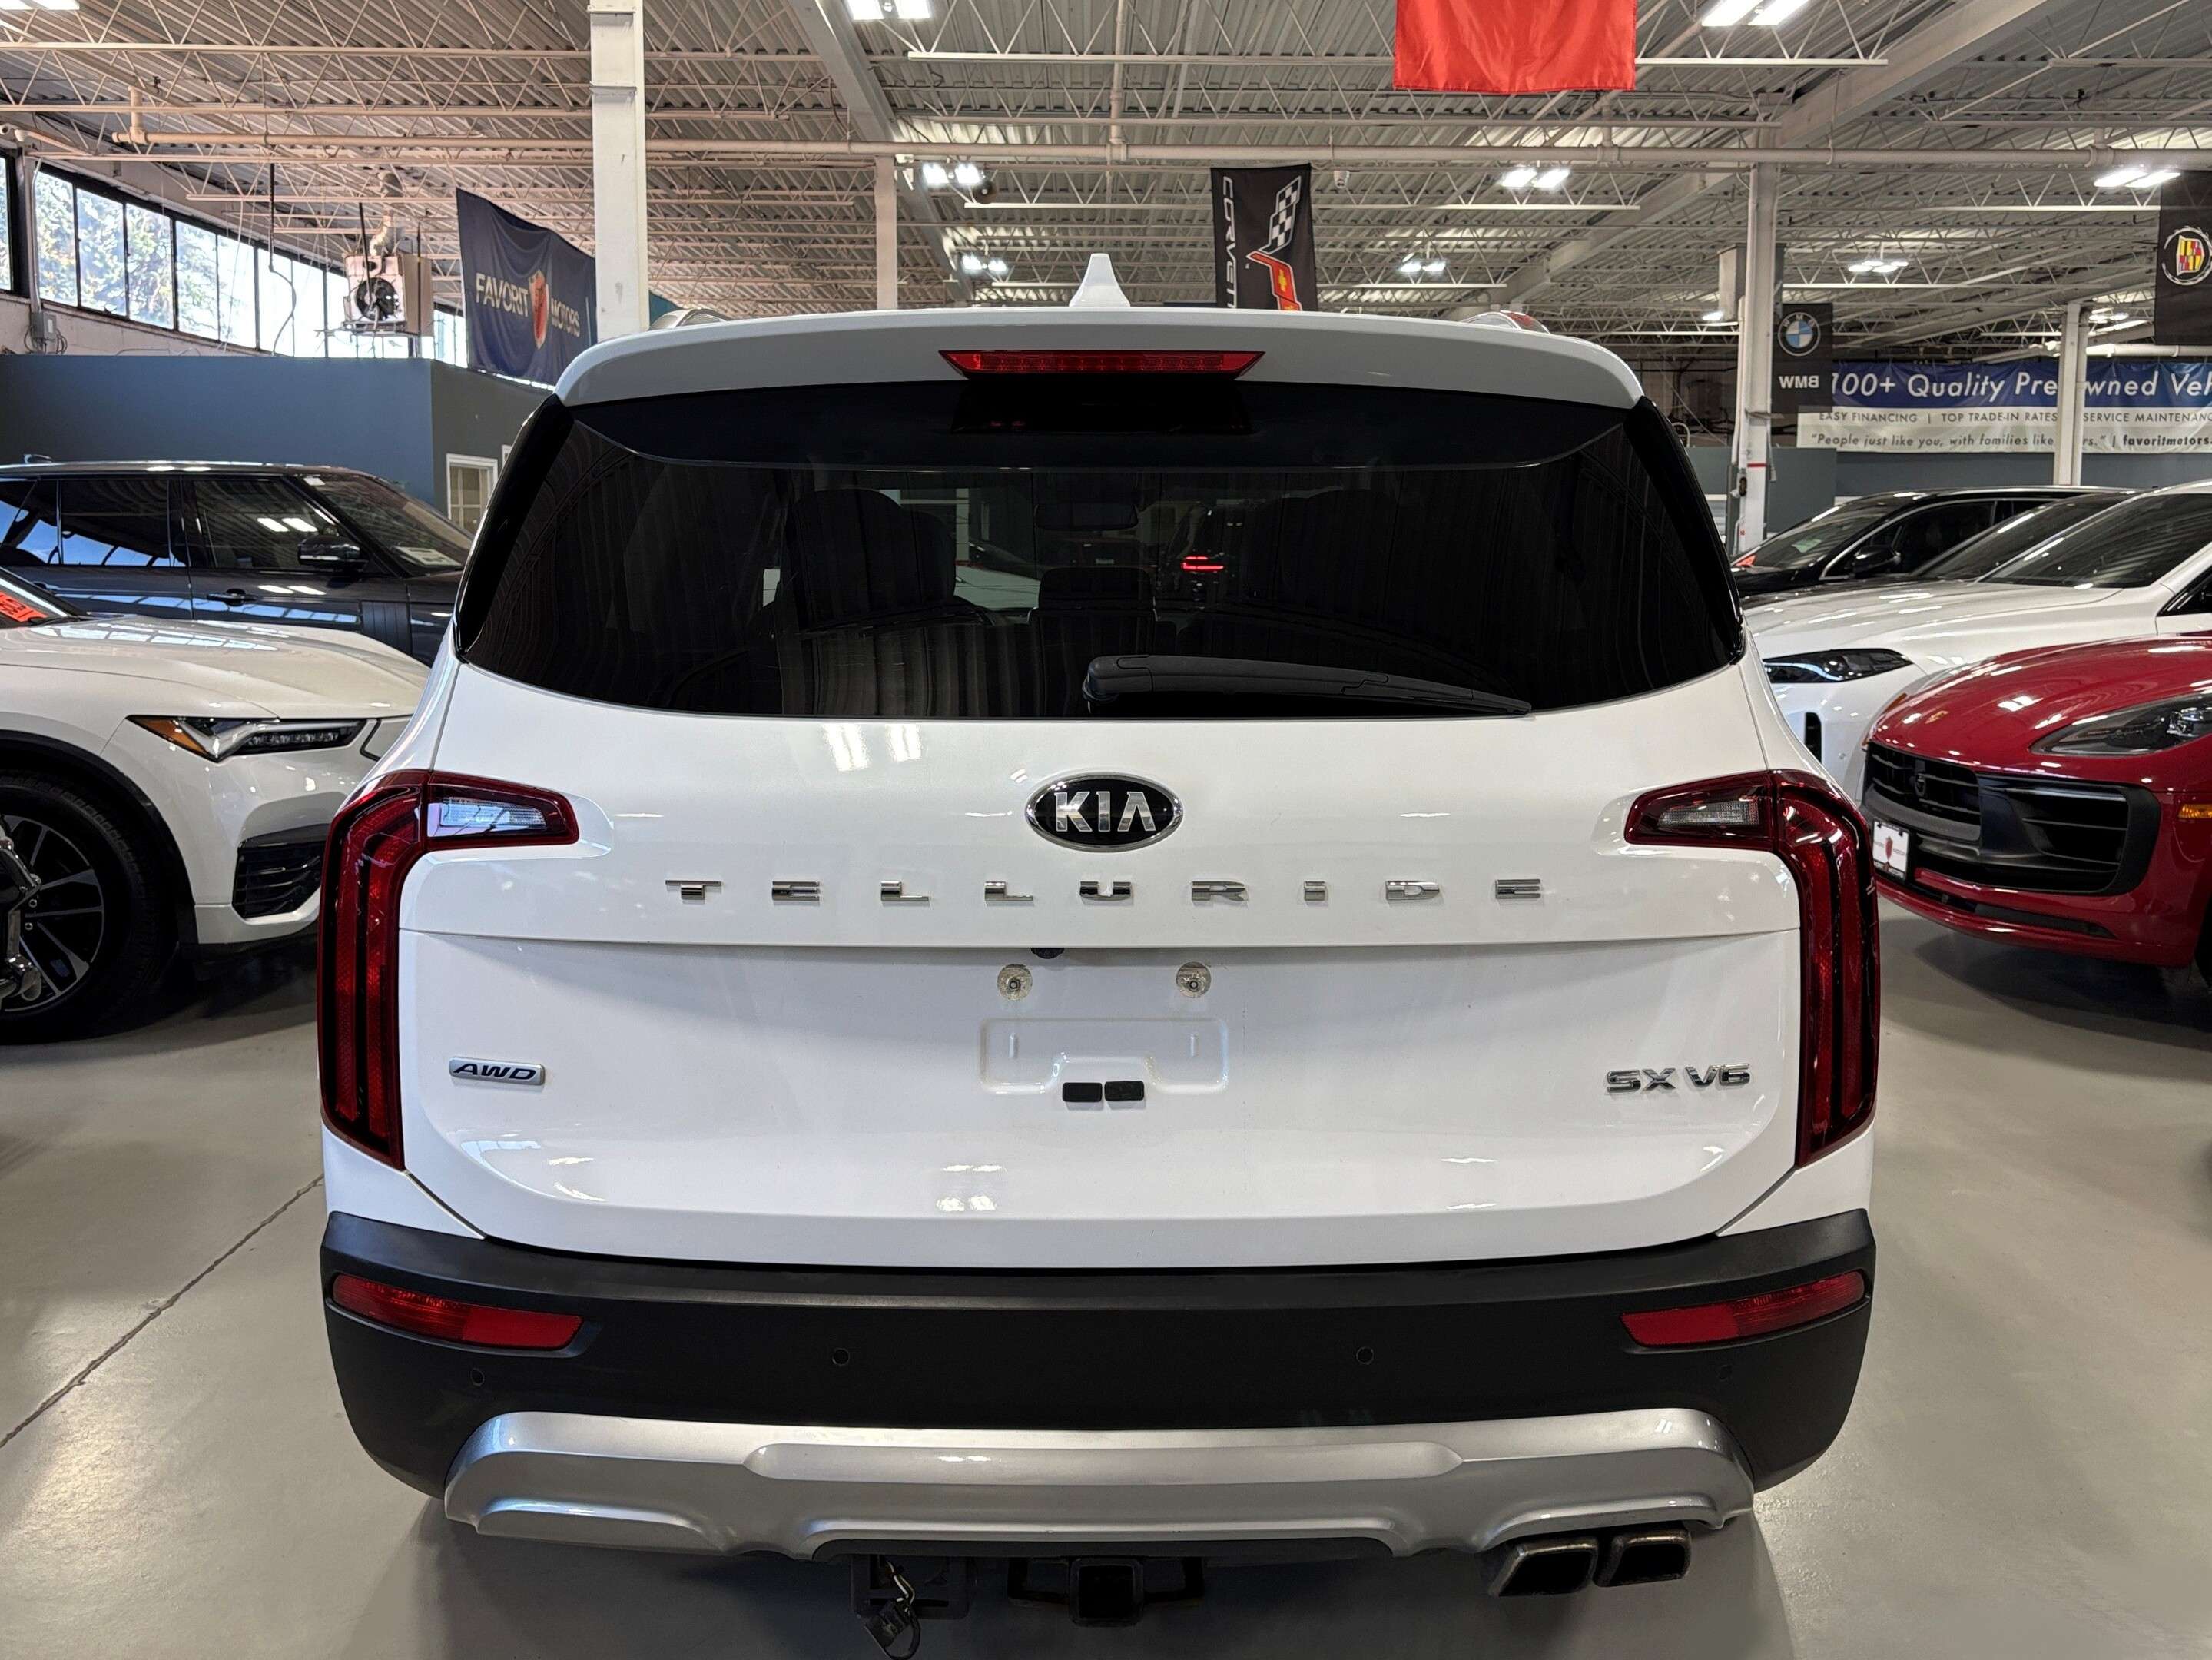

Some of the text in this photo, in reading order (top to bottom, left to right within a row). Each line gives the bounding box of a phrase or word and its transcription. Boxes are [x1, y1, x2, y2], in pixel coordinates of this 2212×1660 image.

[1223, 176, 1237, 308] CORVETT
[476, 273, 580, 337] FAVORIT MOTORS
[1832, 372, 1895, 397] 100+
[1908, 372, 2005, 403] Quality
[2083, 370, 2159, 396] wned
[1819, 412, 1848, 421] EASY
[1852, 412, 1918, 423] FINANCING
[1942, 413, 1964, 422] TOP
[1968, 412, 2019, 422] TRADE-IN
[2025, 412, 2058, 422] RATES
[2083, 412, 2129, 422] SERVICE
[1864, 434, 1887, 448] just
[1892, 435, 1913, 446] like
[1918, 438, 1943, 448] you,
[1949, 434, 1974, 446] with
[1979, 433, 2028, 446] families
[2033, 433, 2054, 446] like
[1054, 791, 1156, 832] KIA
[665, 879, 1543, 902] TELLURIDE
[453, 1063, 536, 1080] AWD
[1607, 1063, 1751, 1093] SX V6
